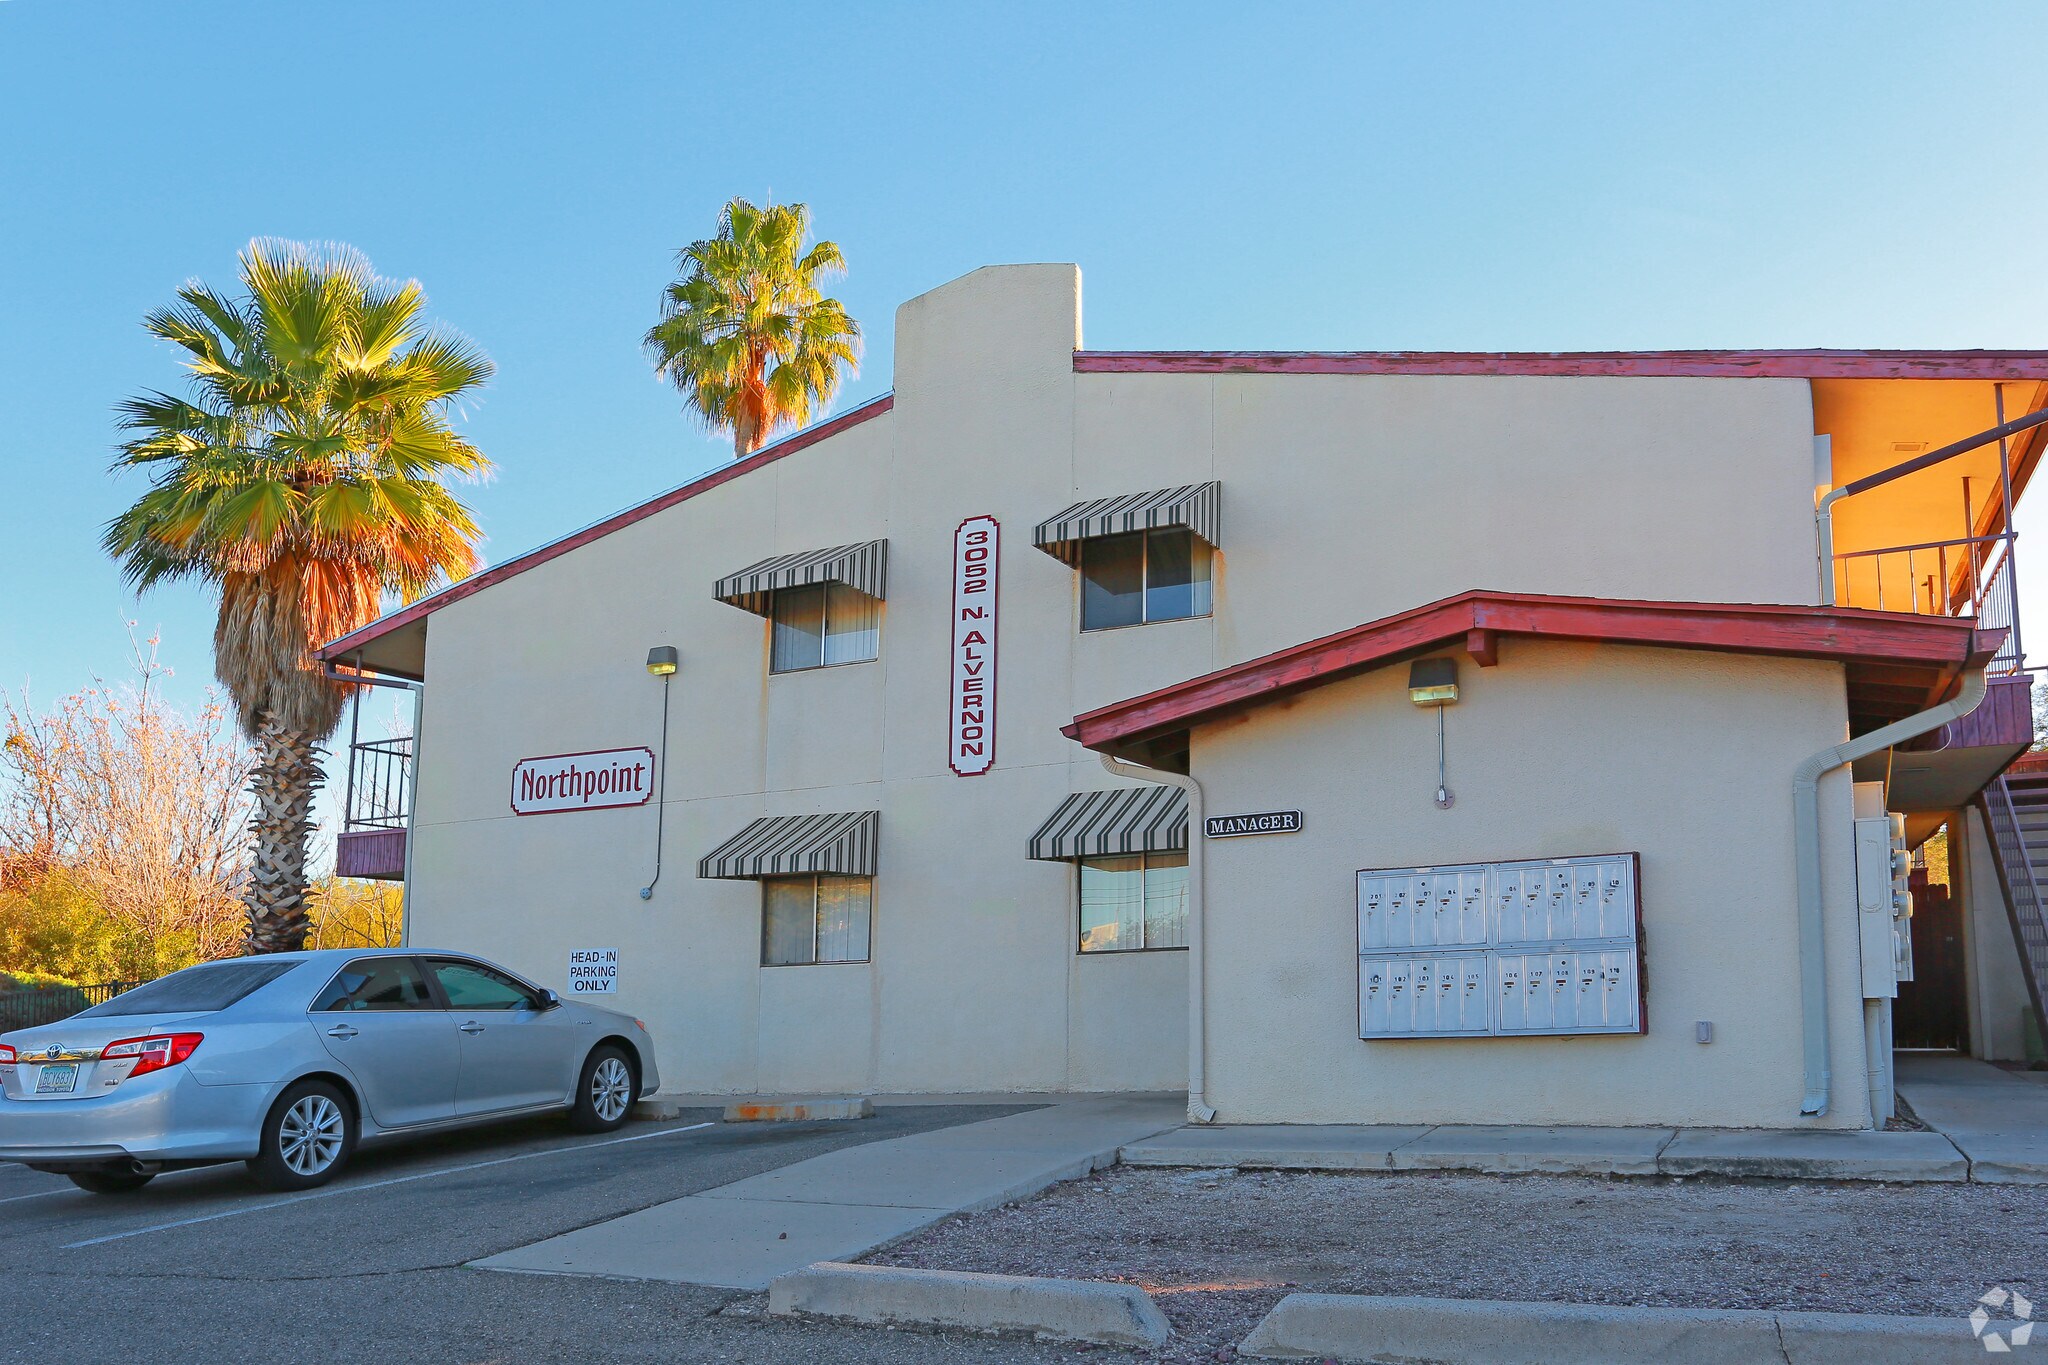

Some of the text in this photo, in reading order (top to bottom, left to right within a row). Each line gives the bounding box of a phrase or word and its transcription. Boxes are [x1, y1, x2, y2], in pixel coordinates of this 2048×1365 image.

[960, 530, 989, 757] 3052 N. ALVERNON
[521, 761, 646, 803] Northpoint
[1210, 814, 1295, 834] MANAGER
[571, 951, 616, 963] HEAD-IN
[570, 966, 616, 978] PARKING
[574, 980, 610, 991] ONLY
